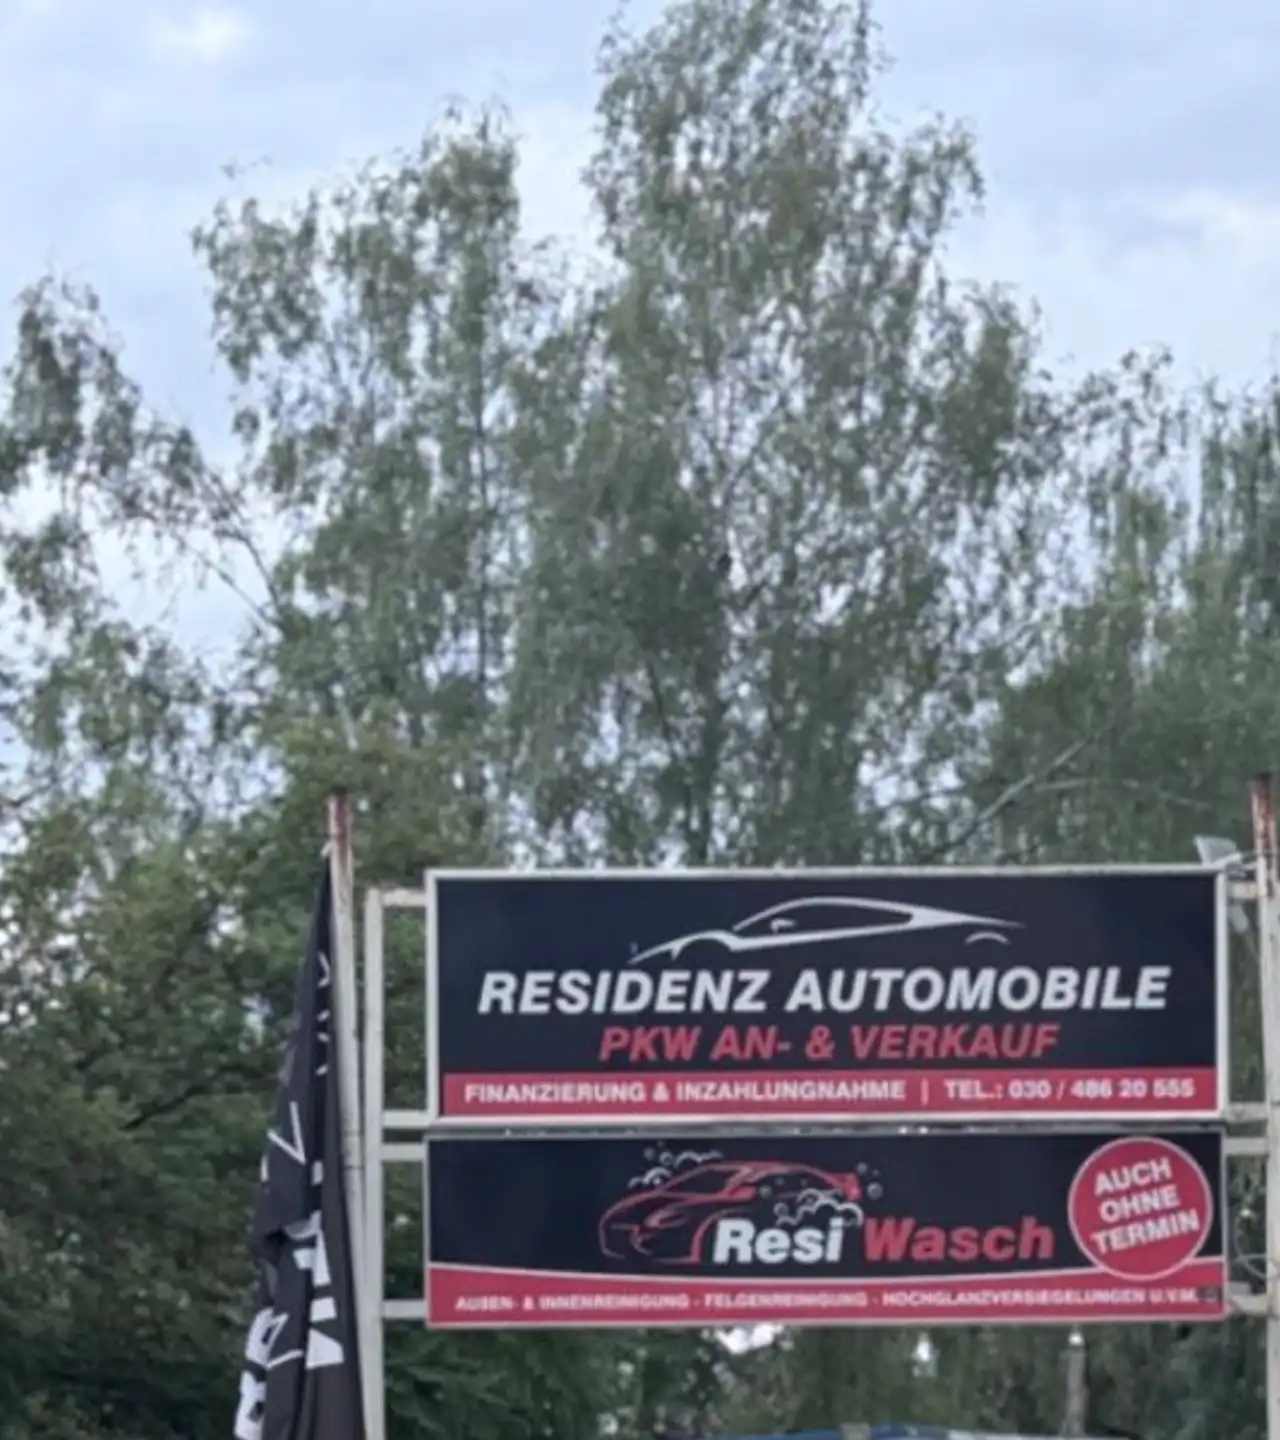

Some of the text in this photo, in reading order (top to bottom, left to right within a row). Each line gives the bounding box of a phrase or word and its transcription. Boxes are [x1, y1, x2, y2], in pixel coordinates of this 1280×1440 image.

[478, 966, 1171, 1014] RESIDENZ AUTOMOBILE
[600, 1022, 1060, 1061] PKW AN- & VERKAUF
[464, 1082, 646, 1103] FINANZIERUNG
[653, 1082, 670, 1102] &
[677, 1079, 906, 1103] INZAHLUNGNAHME
[1008, 1079, 1051, 1099] 030
[1119, 1078, 1146, 1098] 20
[1153, 1078, 1195, 1098] 555
[1094, 1156, 1173, 1196] AUCH
[1100, 1184, 1181, 1223] OHNE
[713, 1217, 1055, 1264] Resi Wasch
[1090, 1208, 1200, 1254] TERMIN
